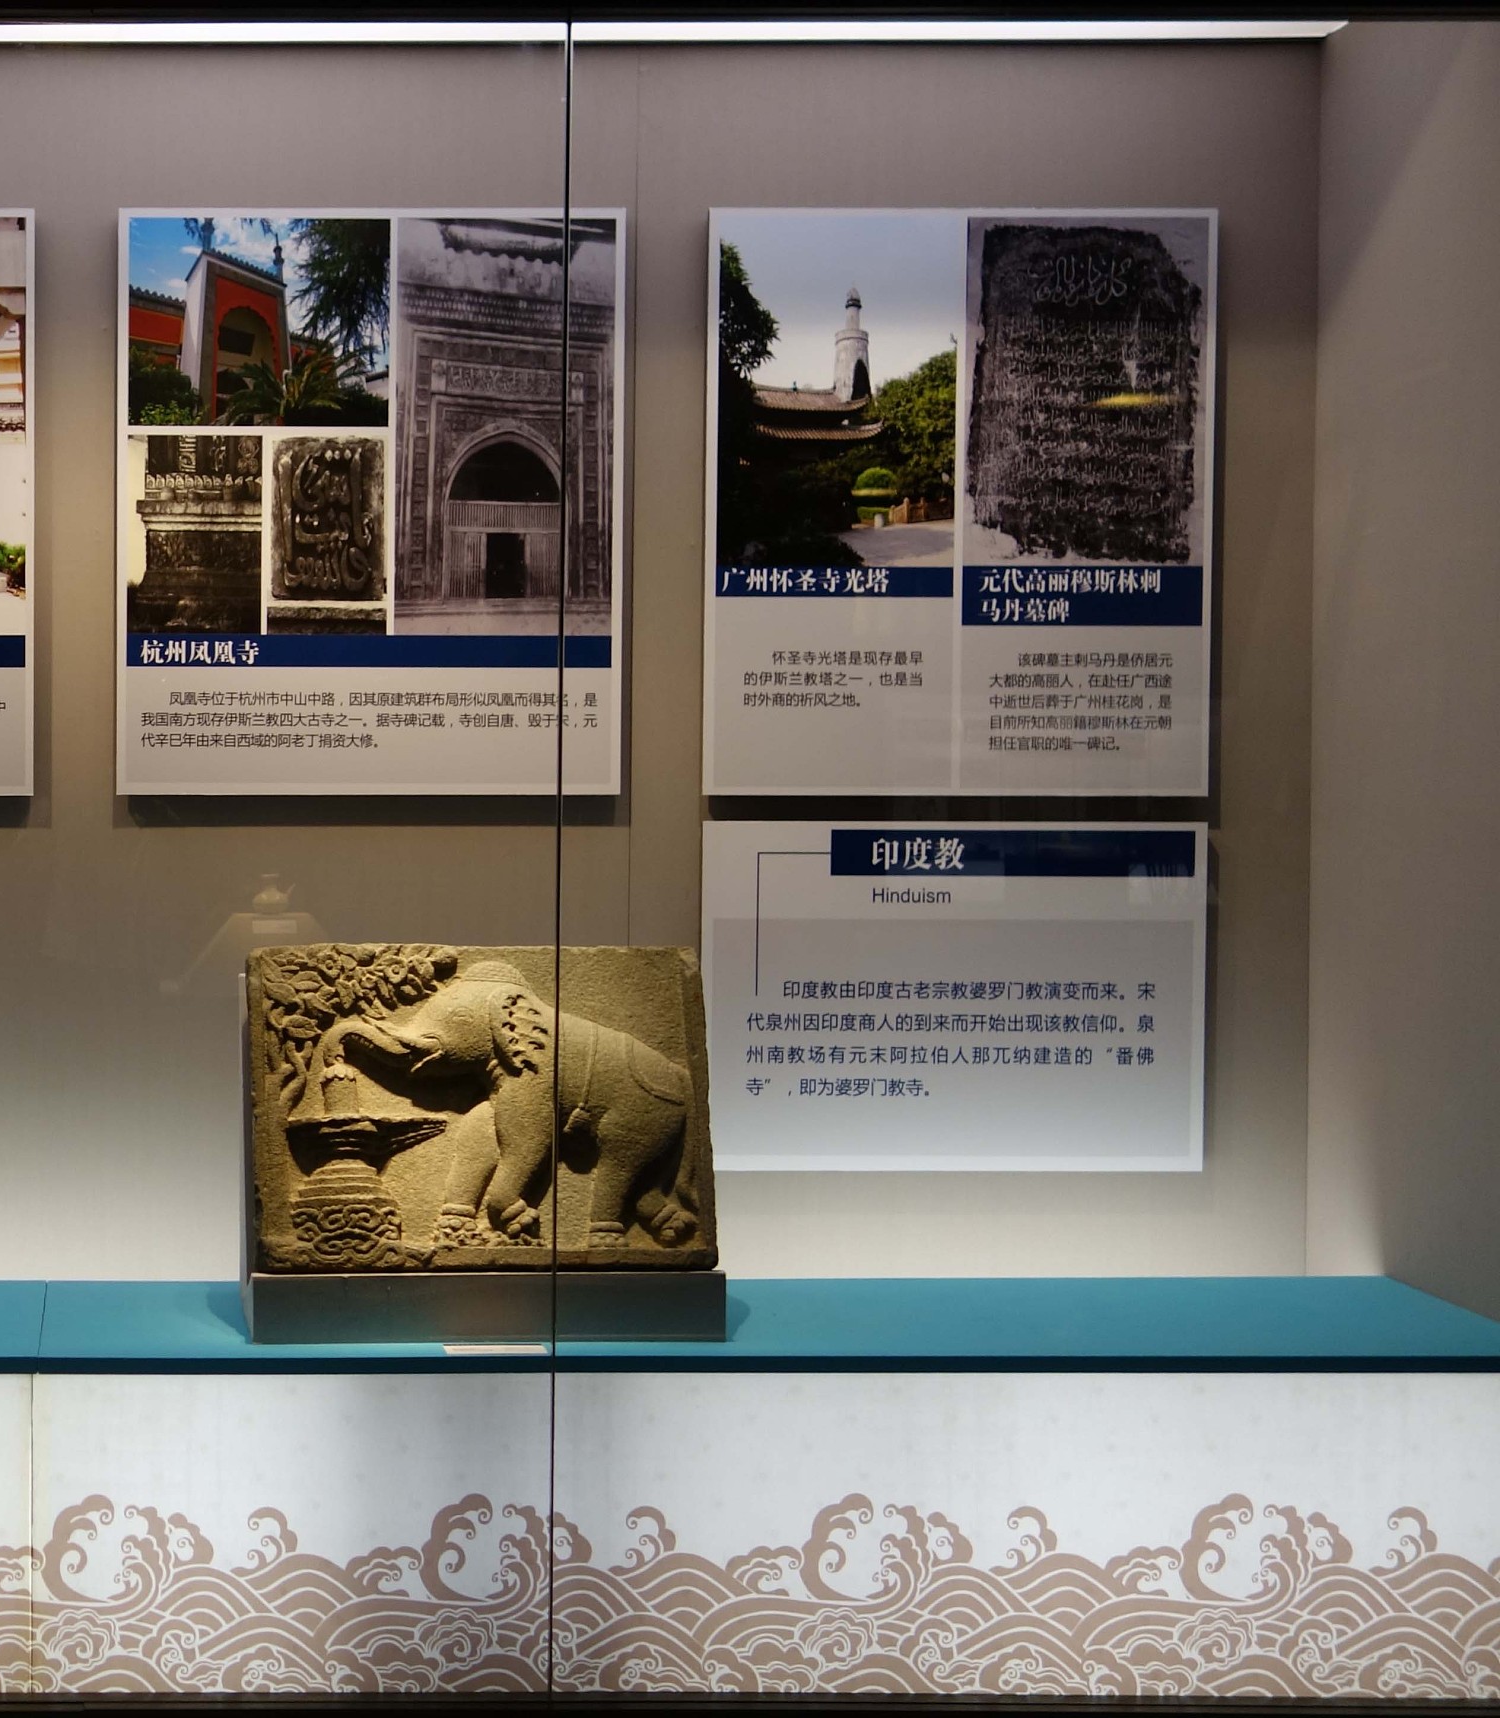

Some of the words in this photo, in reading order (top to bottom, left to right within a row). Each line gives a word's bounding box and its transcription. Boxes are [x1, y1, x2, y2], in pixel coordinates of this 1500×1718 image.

[722, 568, 889, 594] 广州怀圣寺光塔
[978, 569, 1160, 594] 元代高丽穆斯林刺
[978, 598, 1069, 623] 马丹墓碑
[140, 640, 259, 665] 杭州凤凰寺
[772, 651, 922, 666] 怀圣寺光塔是现存最早
[744, 672, 922, 686] 的伊斯兰教塔之一，也是当
[744, 692, 860, 707] 时外商的祈风之地。
[989, 736, 1120, 751] 担任官职的唯一碑记。
[873, 838, 964, 869] 印度教
[873, 888, 951, 904] Hinduism
[783, 980, 1155, 1000] 印度教由印度古老宗教婆罗门教演变而来。宋
[747, 1013, 1154, 1032] 代泉州因印度商人的到来而开始出现该教信仰。泉
